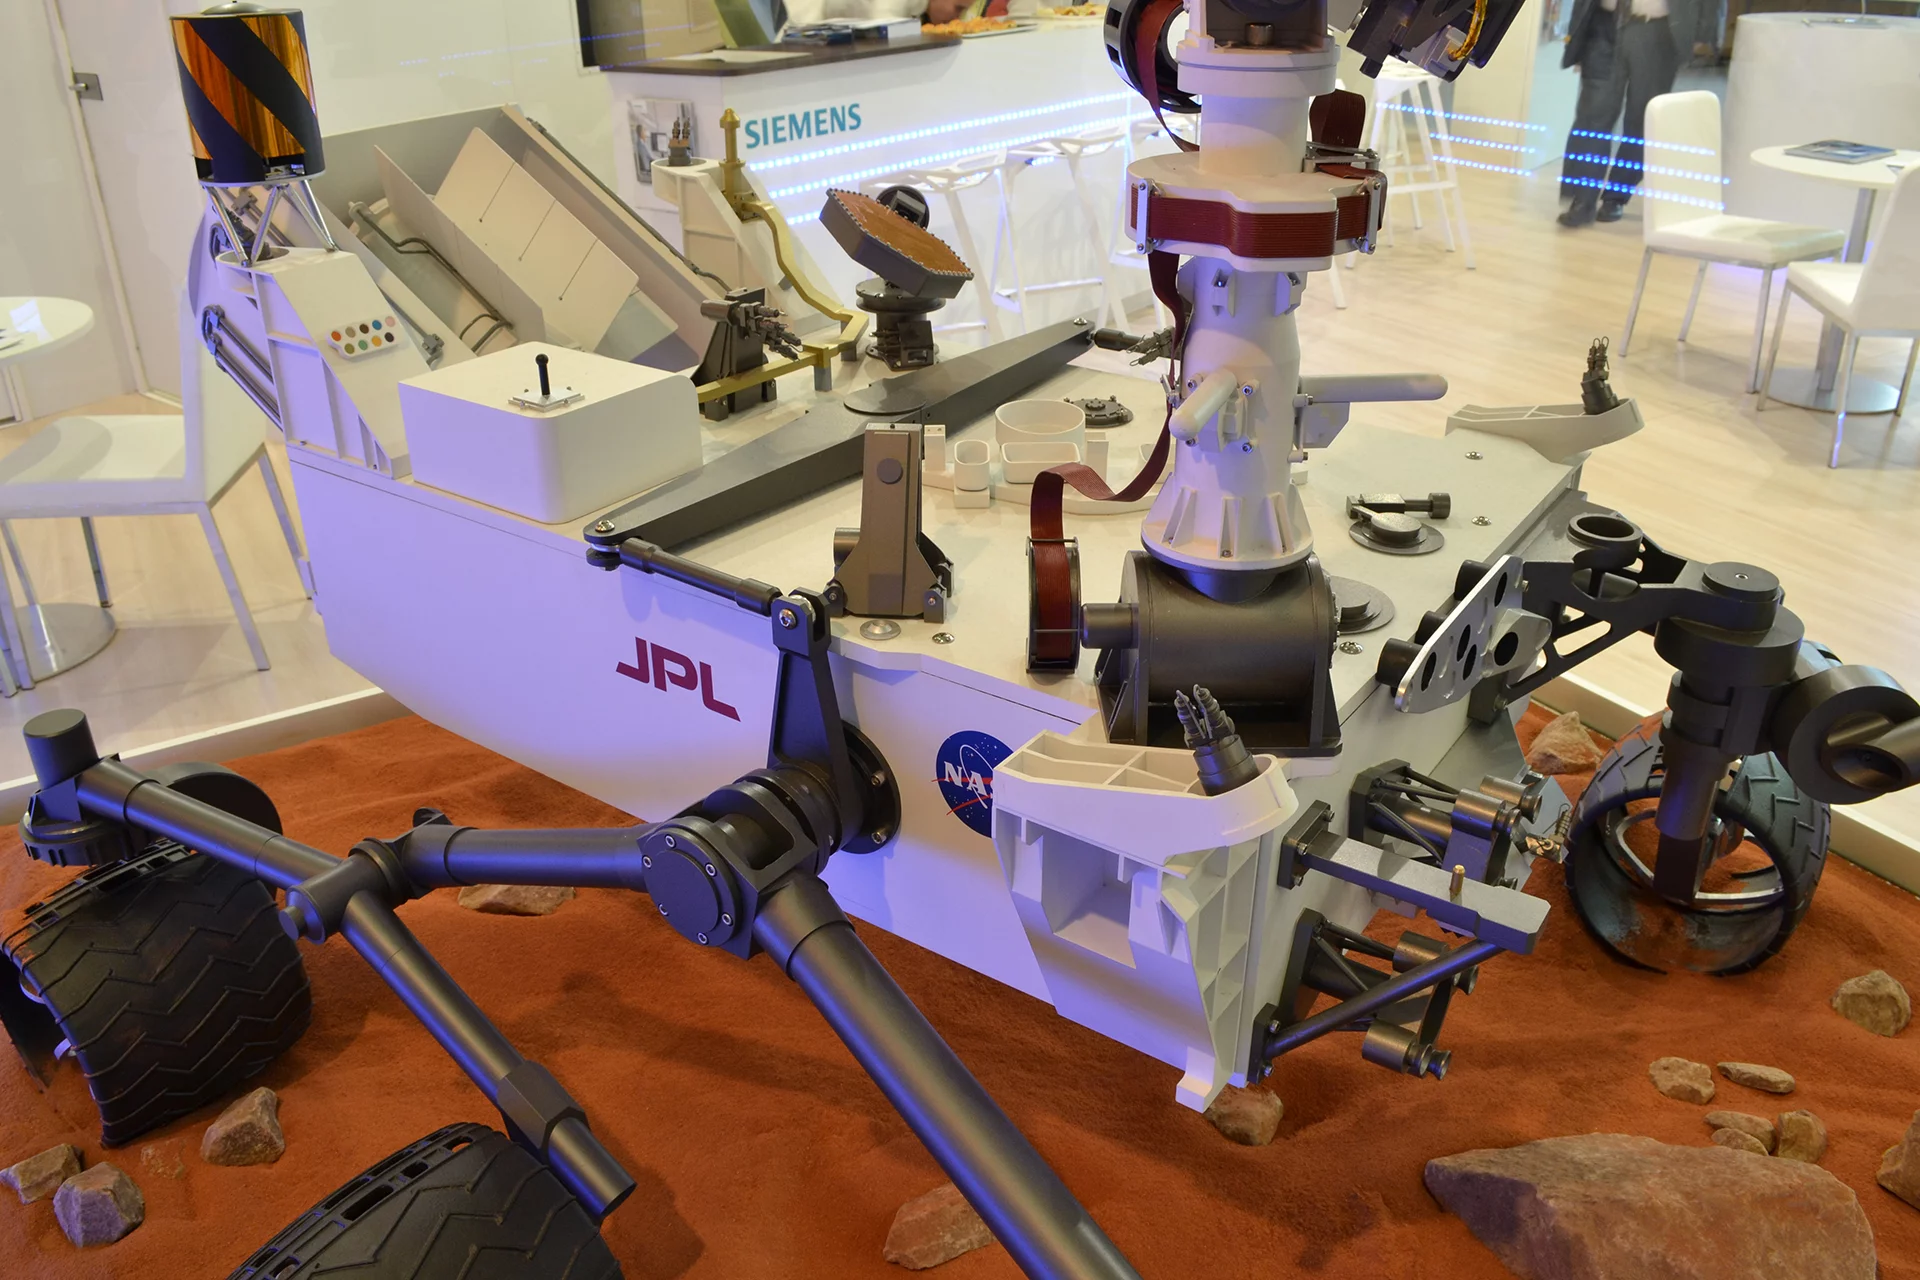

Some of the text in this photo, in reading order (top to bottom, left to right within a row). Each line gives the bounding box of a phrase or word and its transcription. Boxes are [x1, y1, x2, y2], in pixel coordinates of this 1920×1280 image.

[744, 103, 862, 149] SIEMENS
[616, 636, 741, 722] JPL
[944, 760, 993, 799] NA
